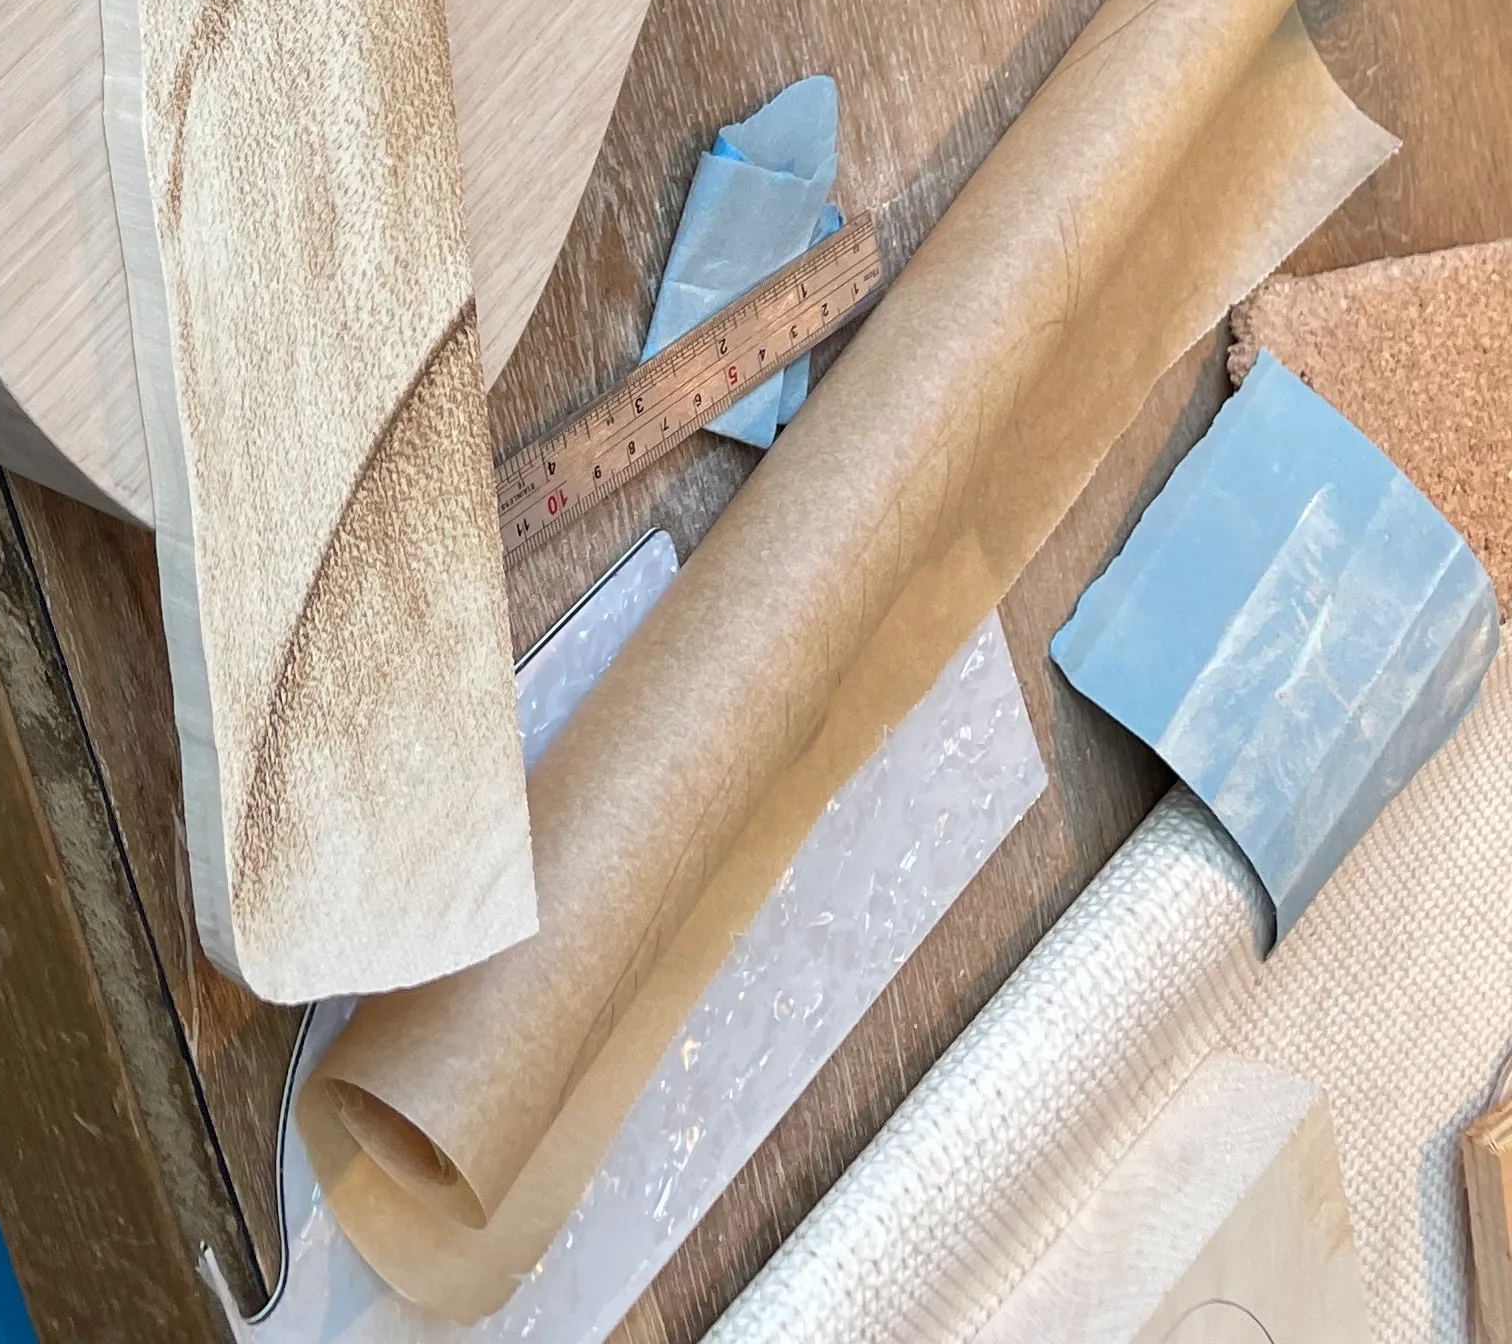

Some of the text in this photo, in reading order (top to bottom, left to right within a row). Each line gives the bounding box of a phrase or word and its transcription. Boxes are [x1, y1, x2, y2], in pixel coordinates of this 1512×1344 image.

[853, 282, 859, 296] 1
[821, 302, 830, 317] 2
[790, 325, 799, 339] 3
[757, 348, 766, 362] 4
[547, 283, 807, 476] 1 2 3 4
[727, 365, 738, 385] 5
[694, 393, 703, 407] 6
[662, 416, 670, 431] 7
[627, 440, 636, 455] 8
[594, 464, 602, 479] 9
[547, 489, 568, 516] 10
[516, 517, 531, 537] 11
